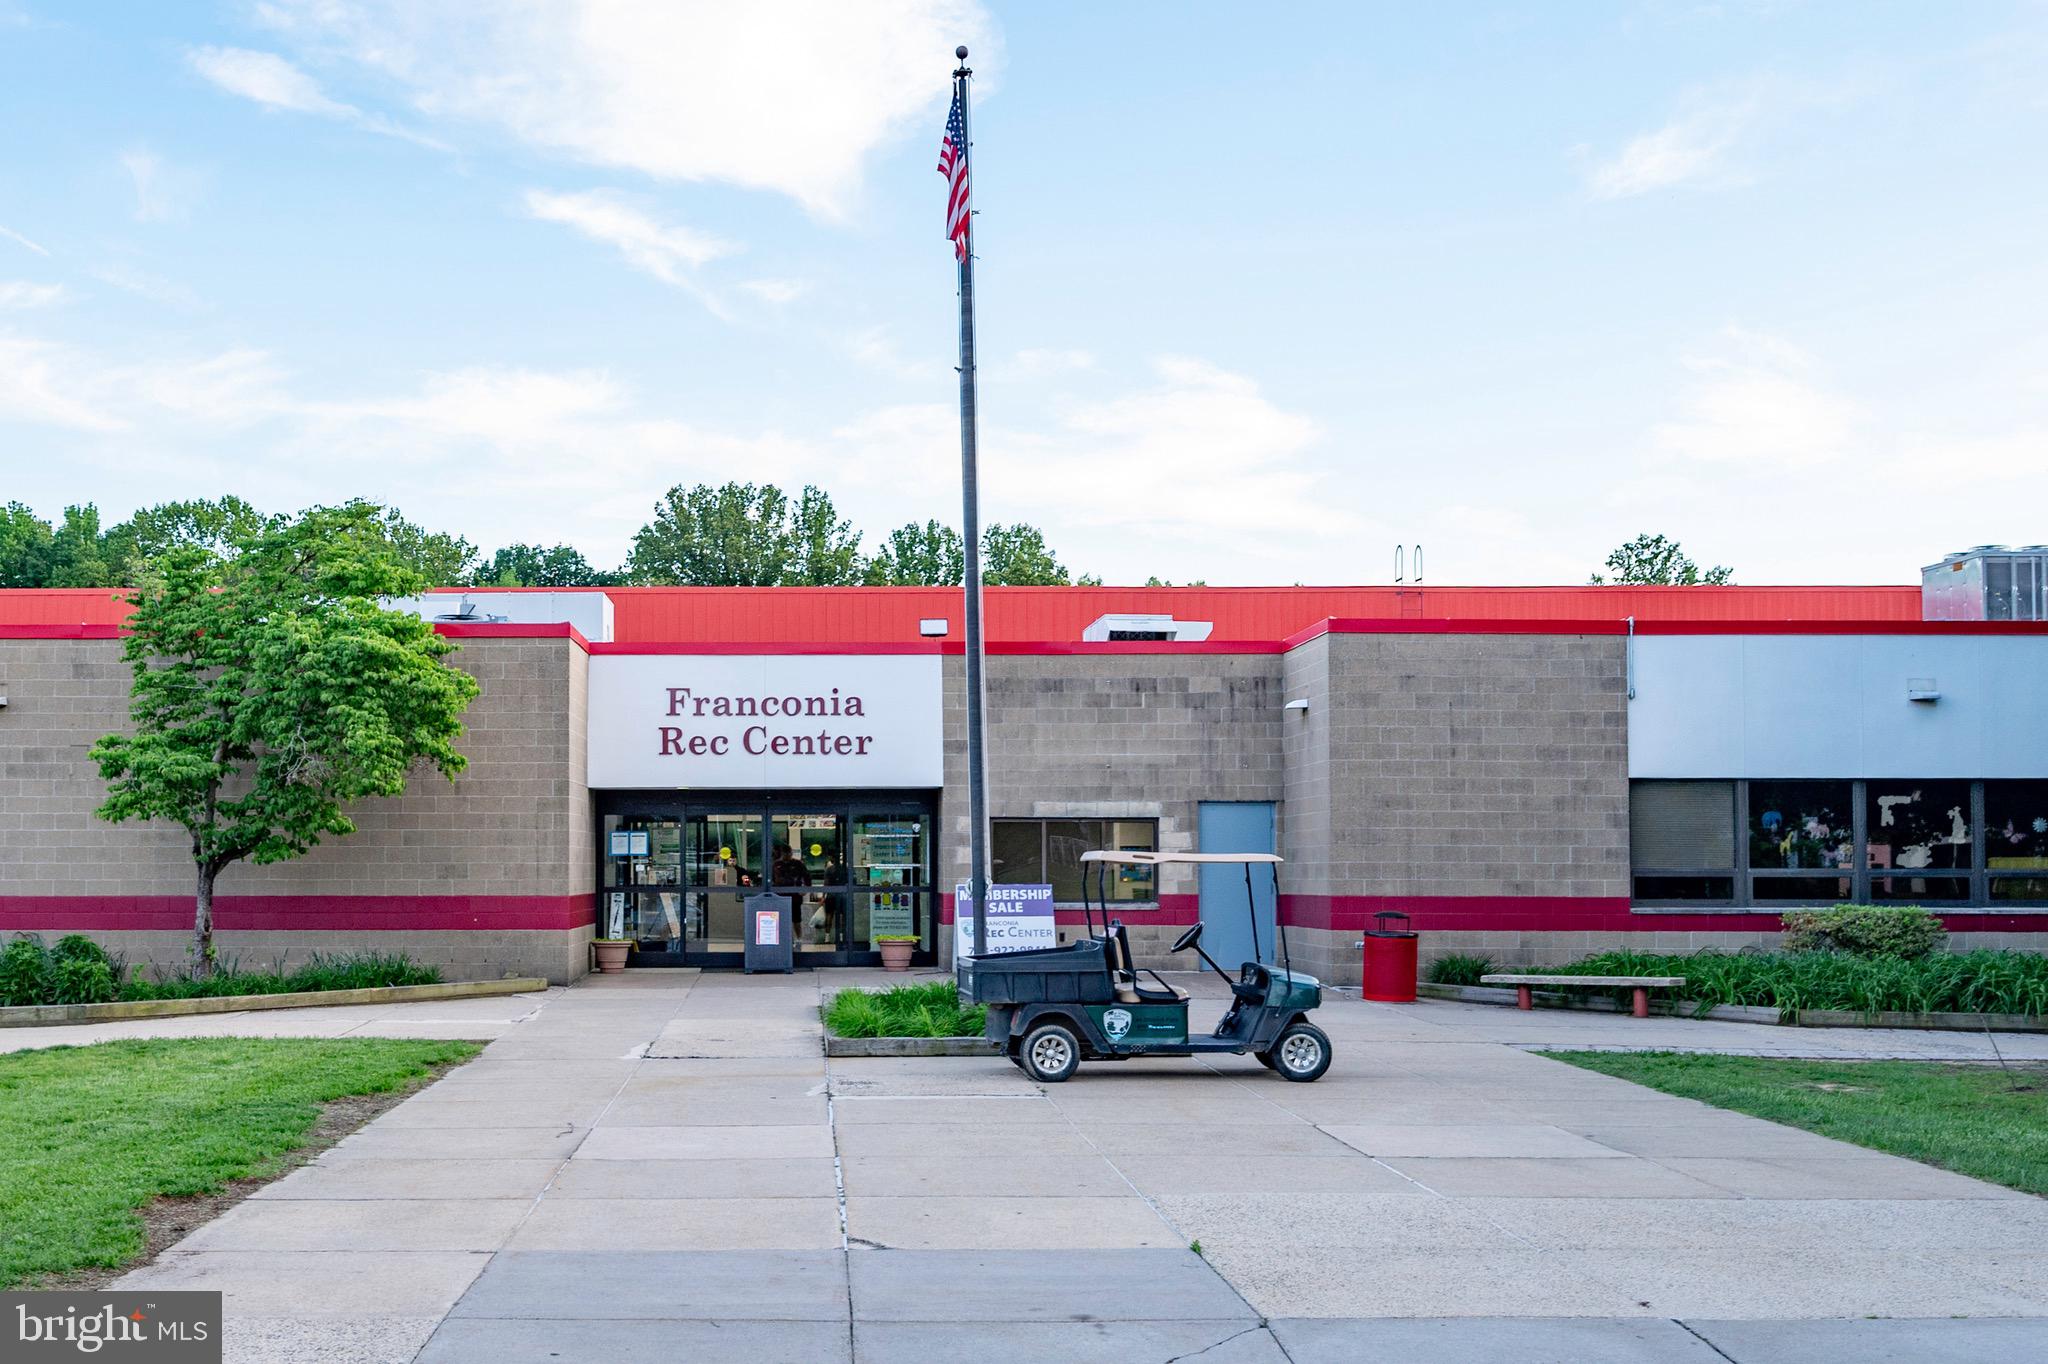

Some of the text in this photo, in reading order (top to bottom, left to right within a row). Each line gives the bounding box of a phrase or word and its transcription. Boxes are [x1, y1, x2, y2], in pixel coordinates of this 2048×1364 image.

[666, 687, 865, 717] Franconia
[658, 725, 873, 756] Rec Center
[959, 889, 1052, 901] MBERSHIP
[988, 901, 1024, 913] SALE
[1007, 926, 1053, 938] CENTER
